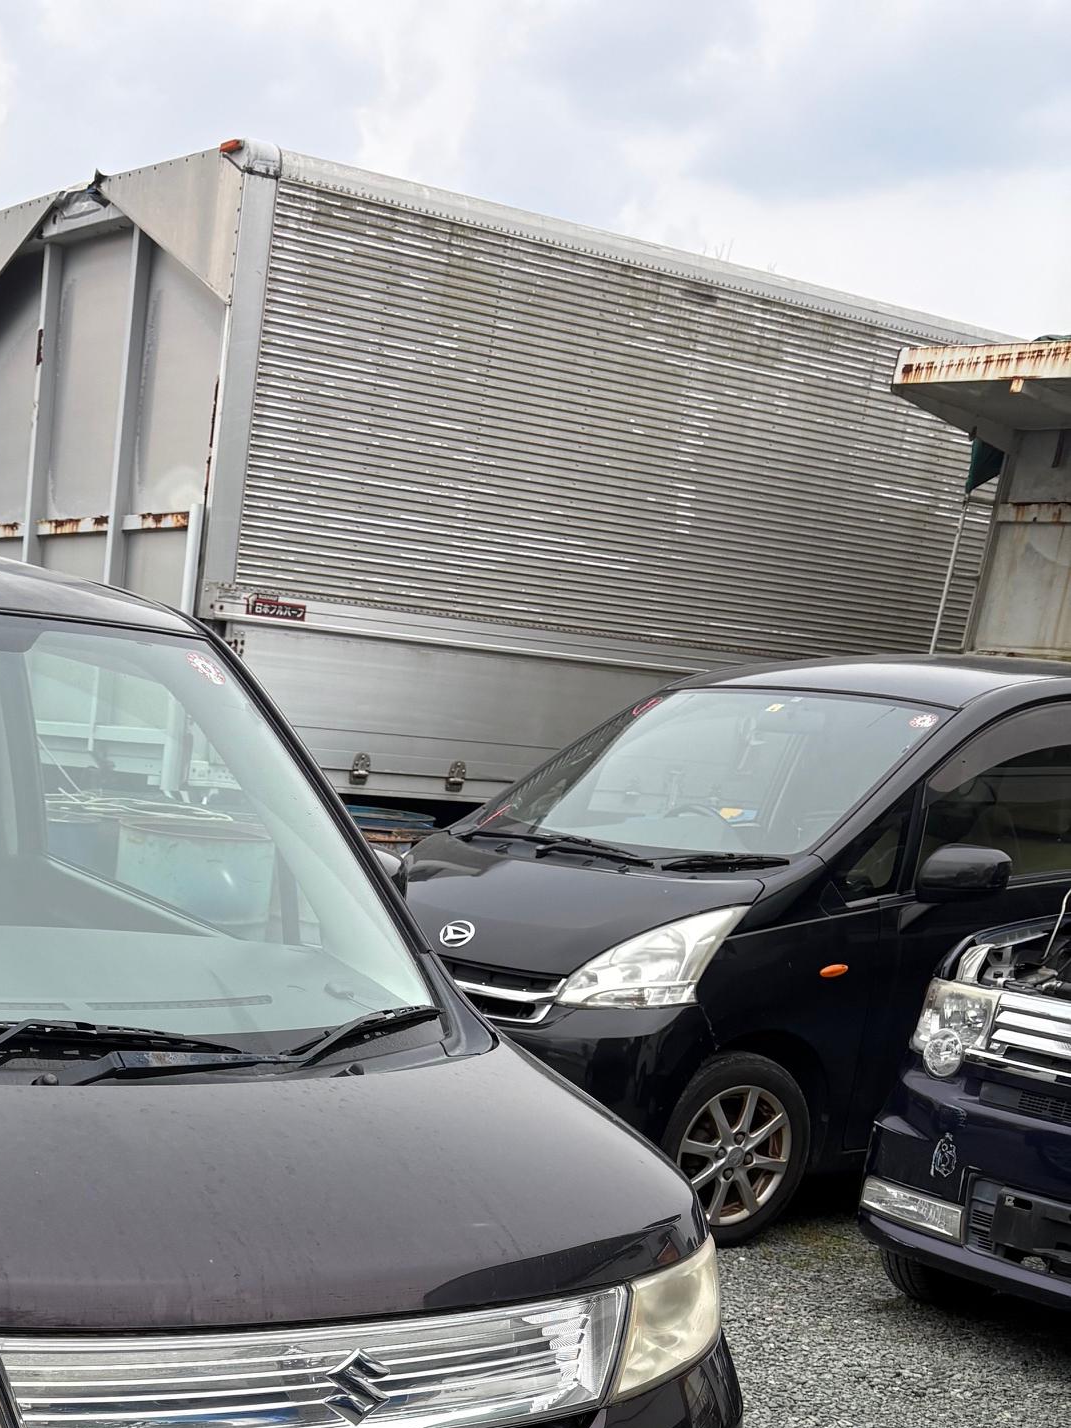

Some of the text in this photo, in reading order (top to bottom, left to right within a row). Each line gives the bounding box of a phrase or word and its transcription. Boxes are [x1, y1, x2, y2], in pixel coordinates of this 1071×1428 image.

[254, 602, 305, 618] 日本フルハーフ
